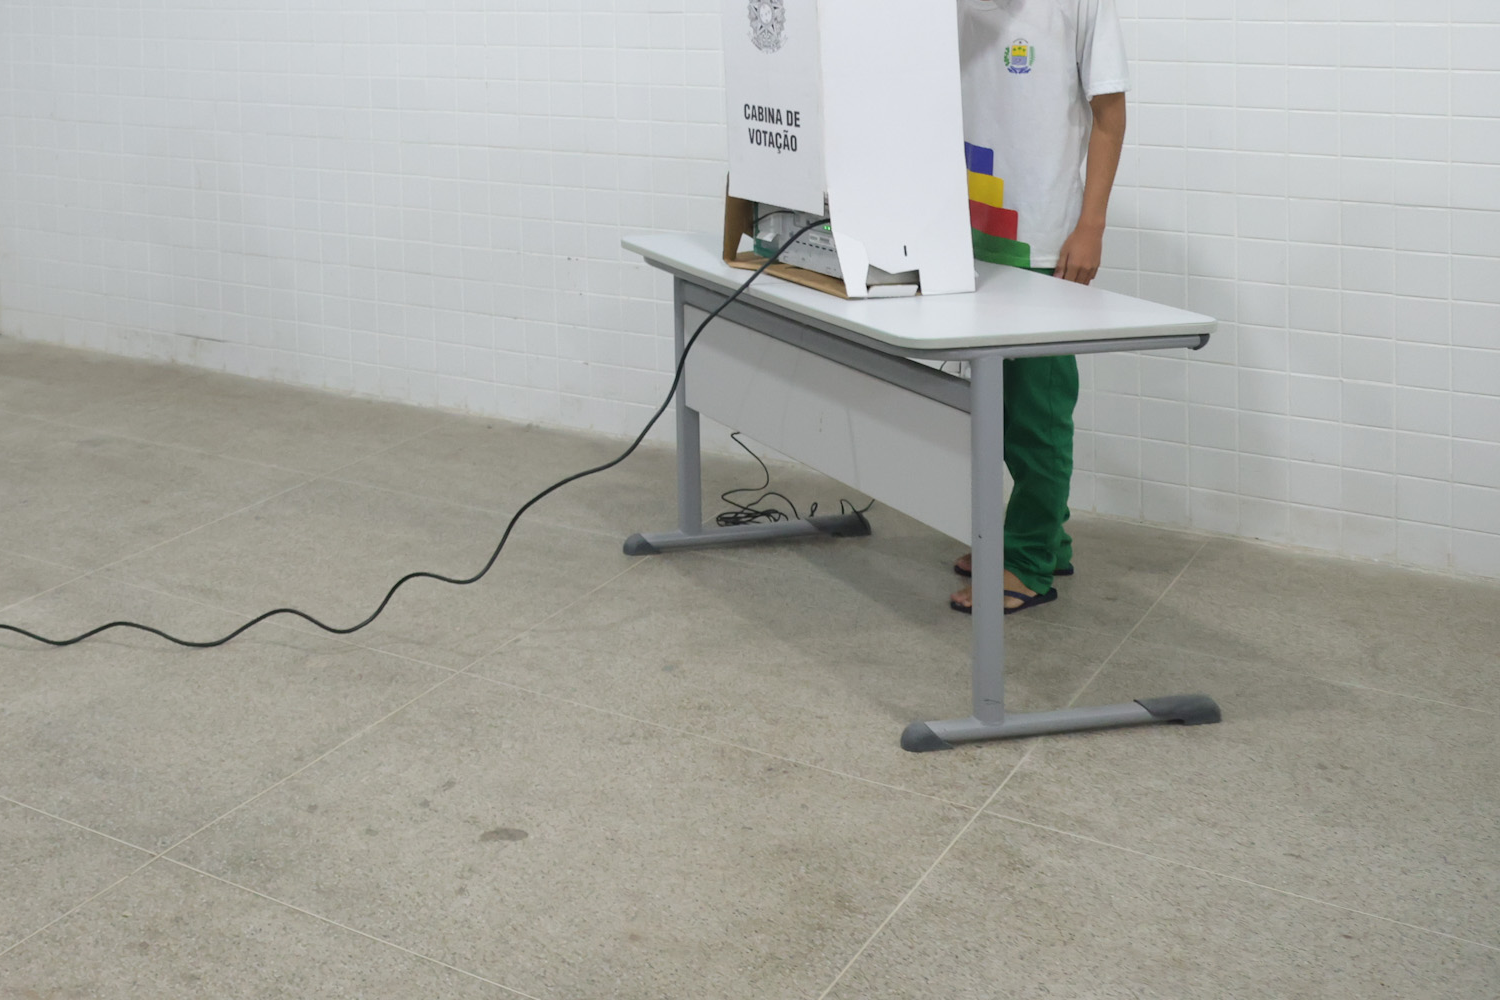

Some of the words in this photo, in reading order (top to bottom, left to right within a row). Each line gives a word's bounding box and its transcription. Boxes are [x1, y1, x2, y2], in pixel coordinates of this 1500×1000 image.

[744, 103, 783, 126] CABINA
[786, 110, 801, 128] DE
[748, 127, 798, 154] VOTAÇÃO
